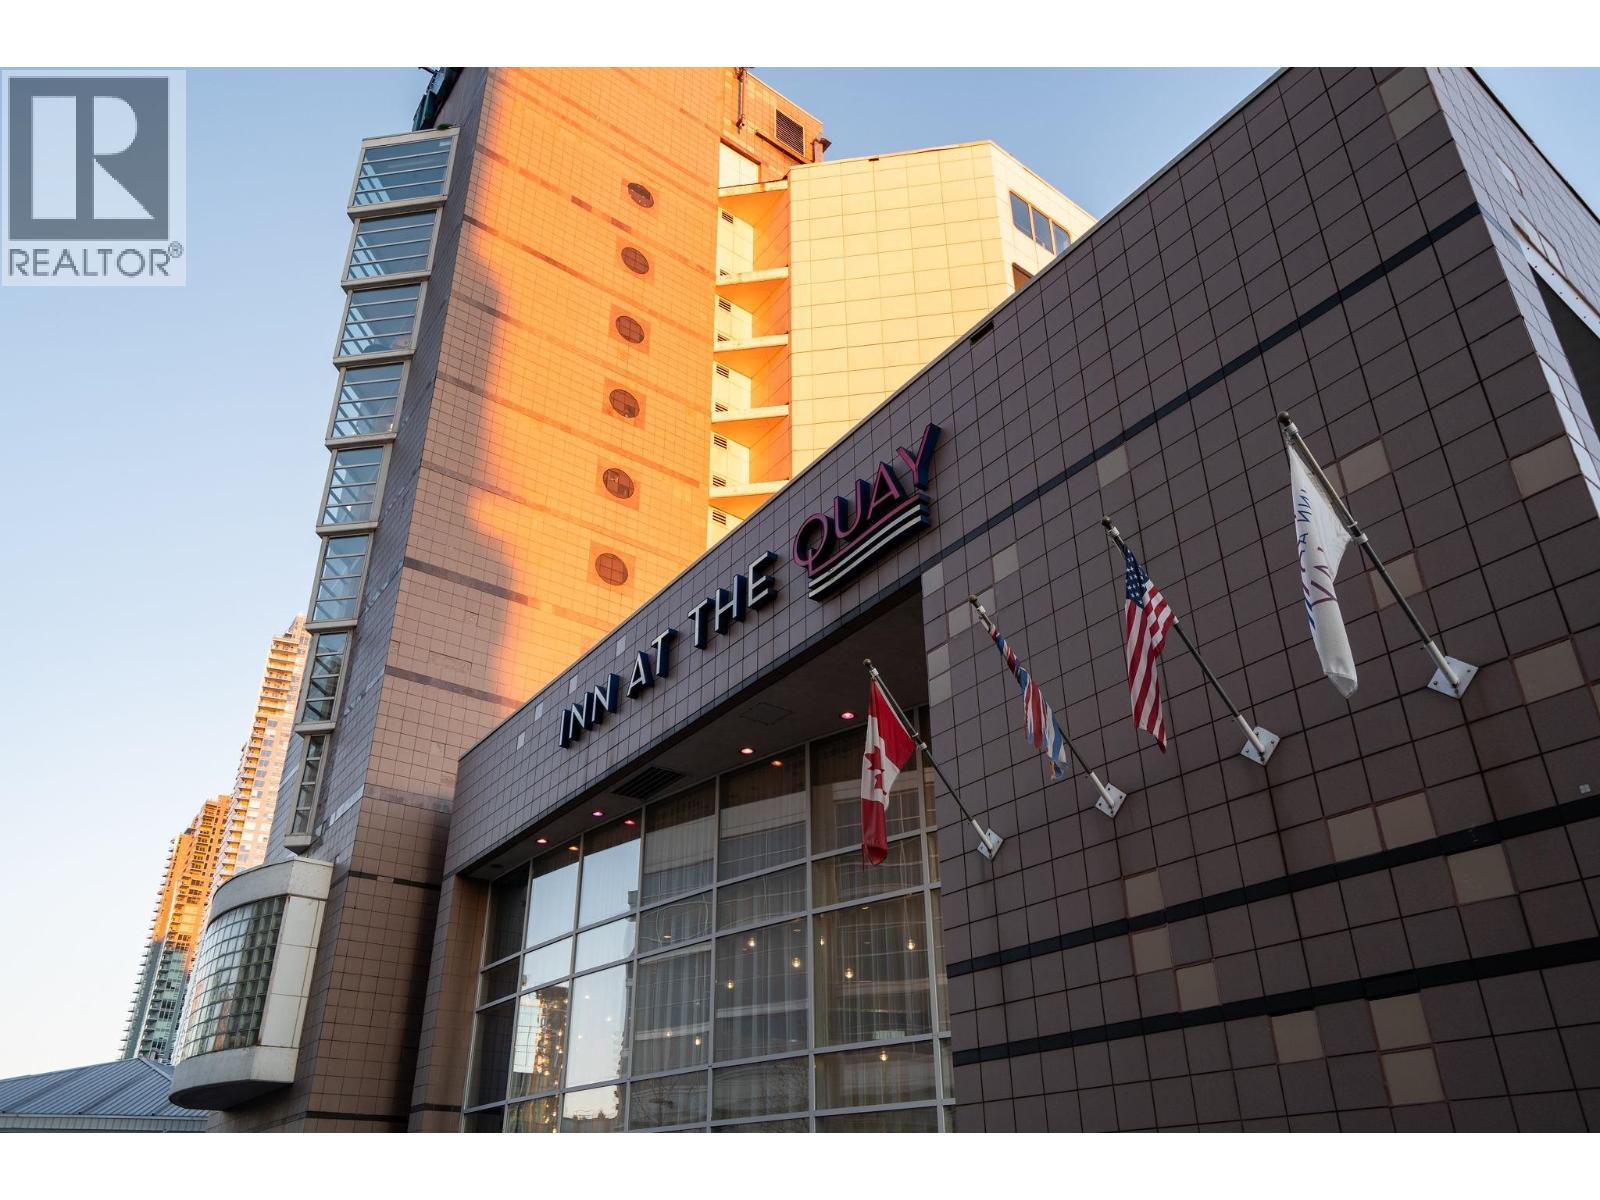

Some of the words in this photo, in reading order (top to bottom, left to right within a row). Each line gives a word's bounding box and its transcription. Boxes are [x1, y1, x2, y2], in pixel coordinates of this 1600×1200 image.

[559, 674, 619, 747] INN
[627, 629, 678, 698] AT
[688, 551, 777, 649] THE
[793, 423, 942, 577] QUAY
